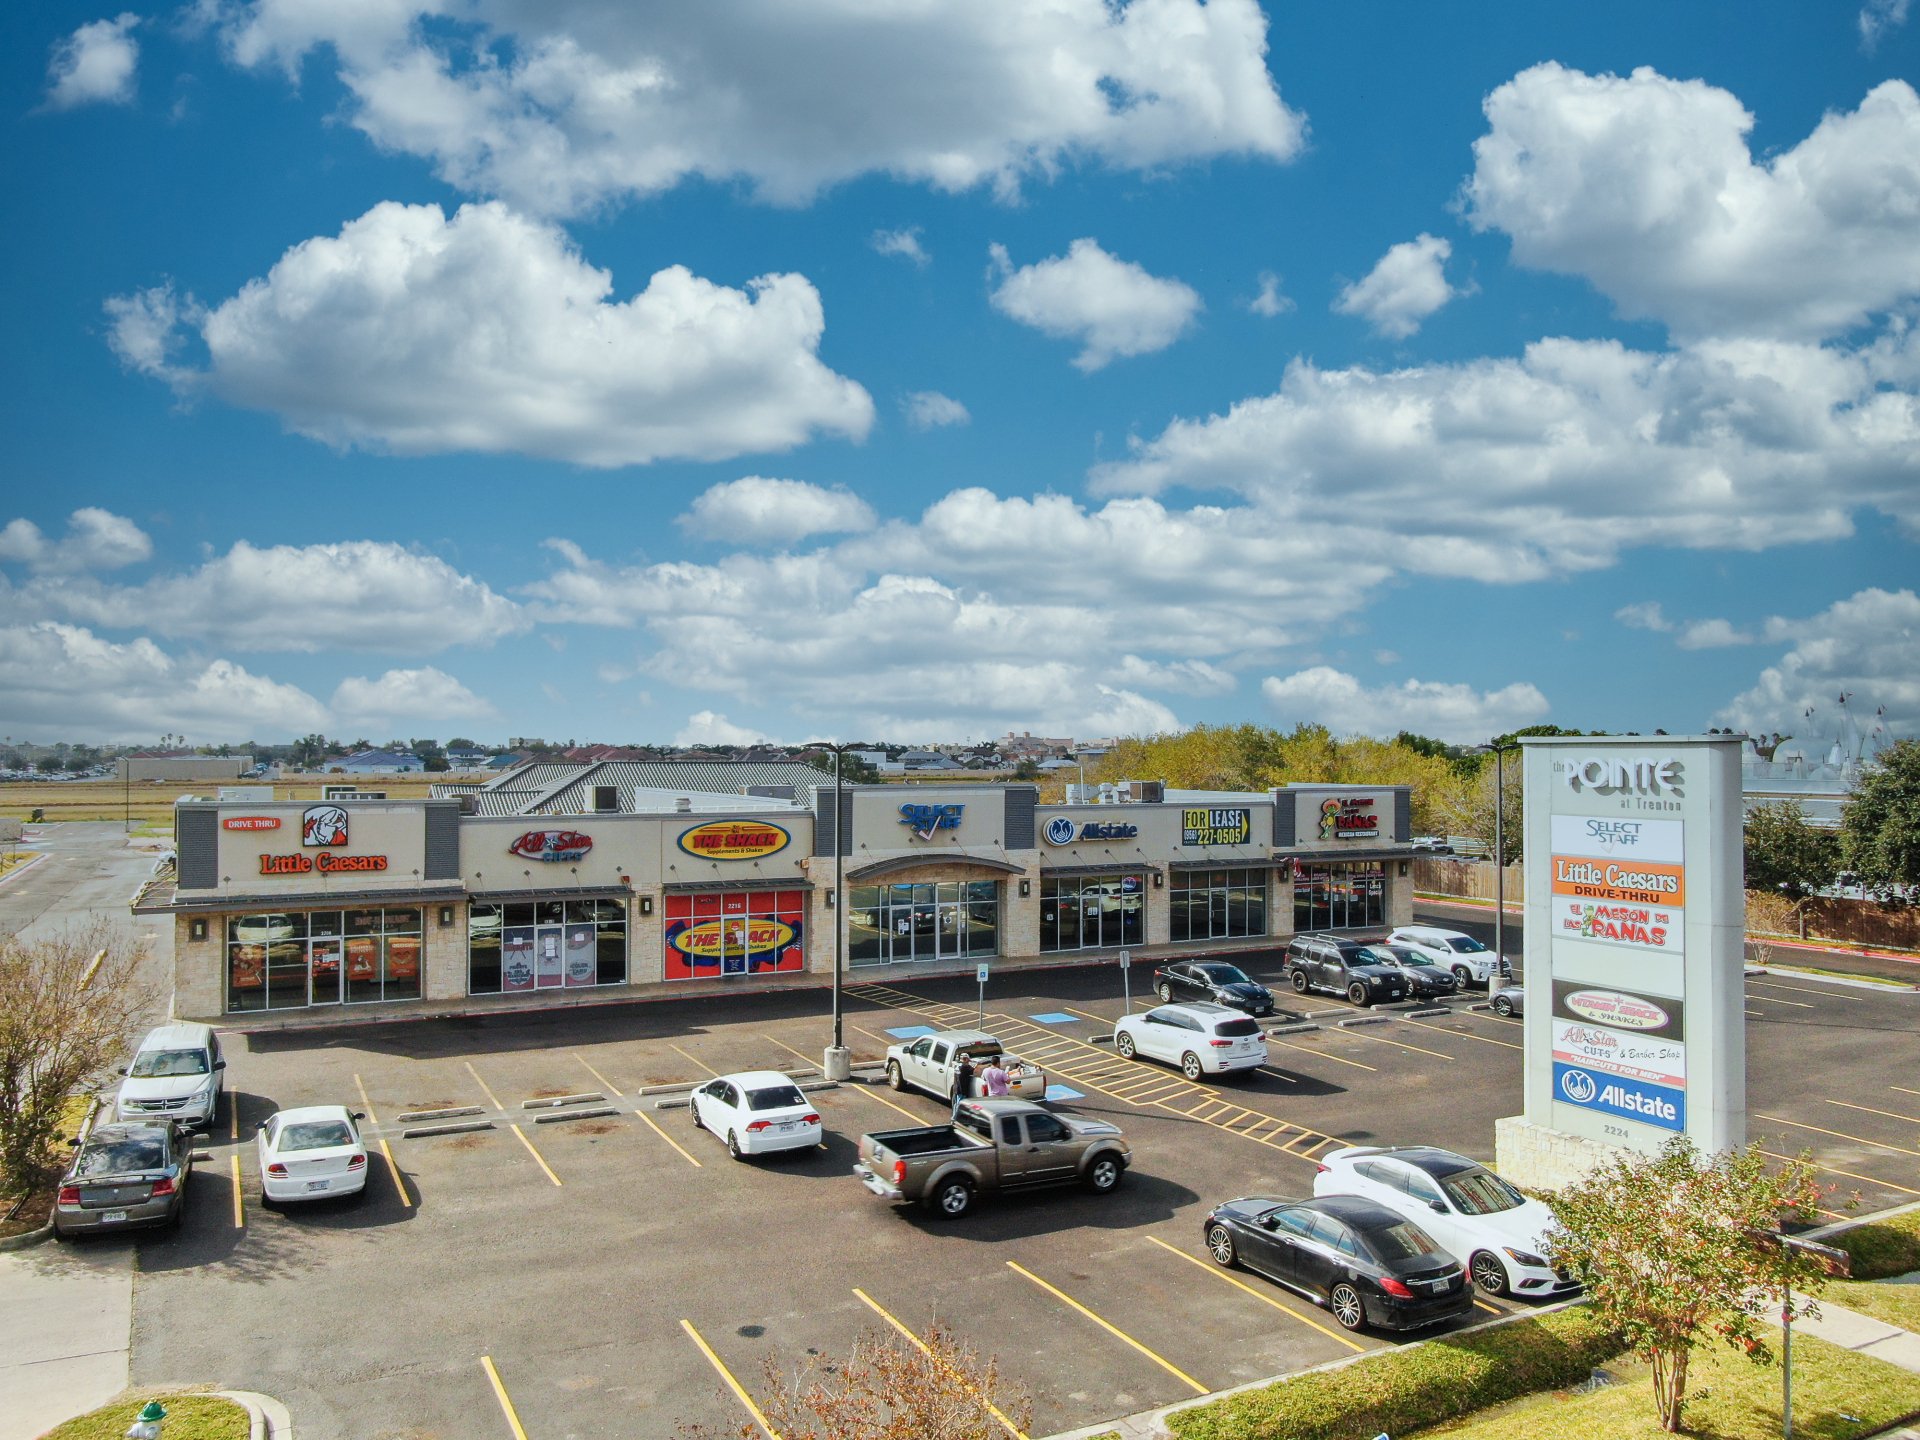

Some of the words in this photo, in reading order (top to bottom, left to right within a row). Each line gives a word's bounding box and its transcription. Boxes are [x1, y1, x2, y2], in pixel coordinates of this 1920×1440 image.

[1564, 756, 1675, 791] POINTE
[1620, 799, 1630, 809] at
[1636, 797, 1681, 812] Trenton
[228, 820, 253, 828] DRIVE
[255, 819, 276, 828] THRU
[1185, 811, 1206, 828] FOR
[1210, 810, 1241, 827] LEASE
[1586, 819, 1642, 837] SELECT
[1079, 821, 1138, 841] Allstate
[1197, 828, 1241, 845] 227-0505
[1598, 832, 1639, 845] STAFF
[693, 834, 724, 849] THE
[725, 833, 778, 848] SHACK
[259, 853, 312, 875] Little
[315, 851, 388, 873] Caesars
[1556, 860, 1602, 886] Little
[1605, 863, 1679, 893] Caesars
[1574, 885, 1660, 903] DRIVE-THRU
[1570, 904, 1582, 915] EL
[684, 932, 720, 948] THE
[724, 928, 782, 945] SACK
[1564, 918, 1582, 930] LAS
[1591, 917, 1667, 947] RANAS
[1571, 996, 1617, 1013] VITAMIN
[1619, 1004, 1660, 1021] SHACK
[1560, 1026, 1586, 1043] All
[1590, 1027, 1618, 1048] Star
[1584, 1046, 1611, 1059] CUTS
[1620, 1049, 1626, 1059] &
[1628, 1048, 1656, 1059] Barber
[1659, 1048, 1681, 1060] Shop
[1619, 1064, 1638, 1076] FOR
[1597, 1084, 1676, 1121] Allstate
[1604, 1124, 1629, 1139] 2224
